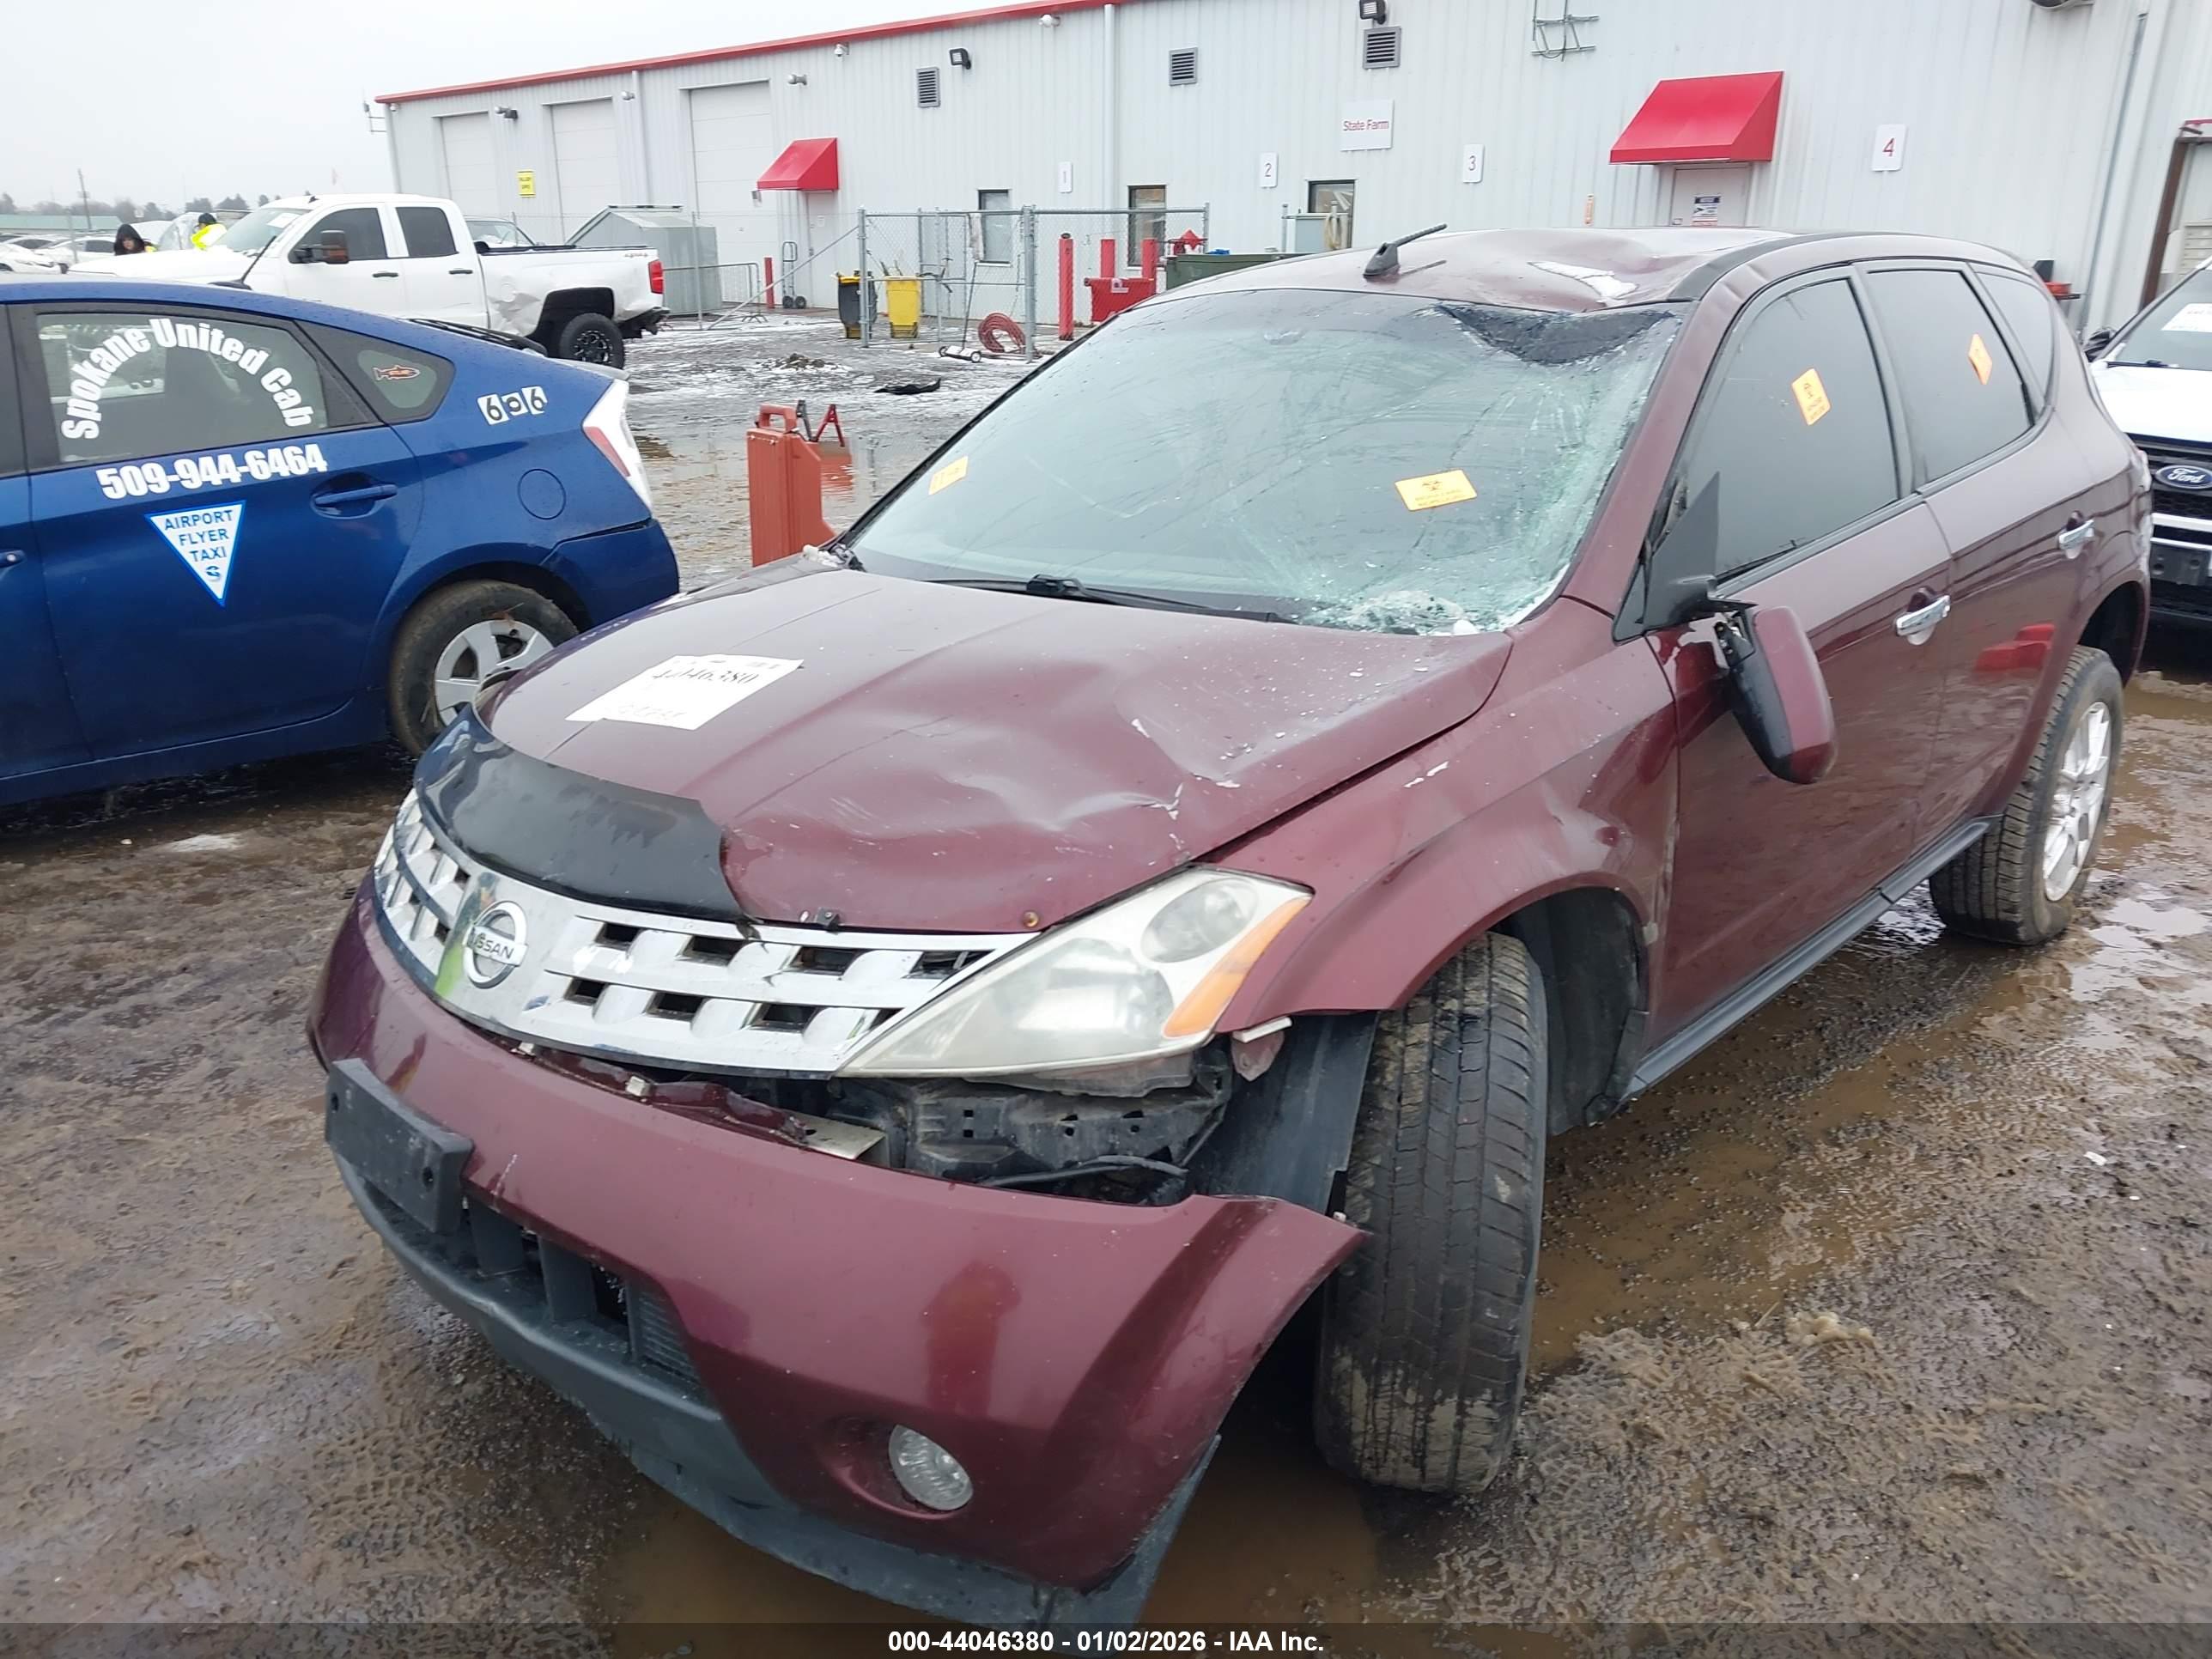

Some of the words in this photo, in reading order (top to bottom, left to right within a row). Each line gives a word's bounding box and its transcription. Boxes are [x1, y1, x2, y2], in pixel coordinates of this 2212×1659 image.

[1343, 119, 1364, 131] State
[1367, 119, 1389, 130] Farm
[1882, 137, 1895, 157] 4
[1265, 162, 1272, 177] 2
[1468, 155, 1476, 171] 3
[61, 328, 151, 440] Spokane
[149, 318, 270, 375] United
[260, 367, 314, 428] Cab
[95, 443, 328, 500] 509-944-6464
[2167, 468, 2206, 483] Ford
[165, 509, 233, 531] AIRPORT
[179, 528, 228, 546] FLYER
[190, 546, 227, 562] TAXI
[470, 929, 515, 960] SSAN
